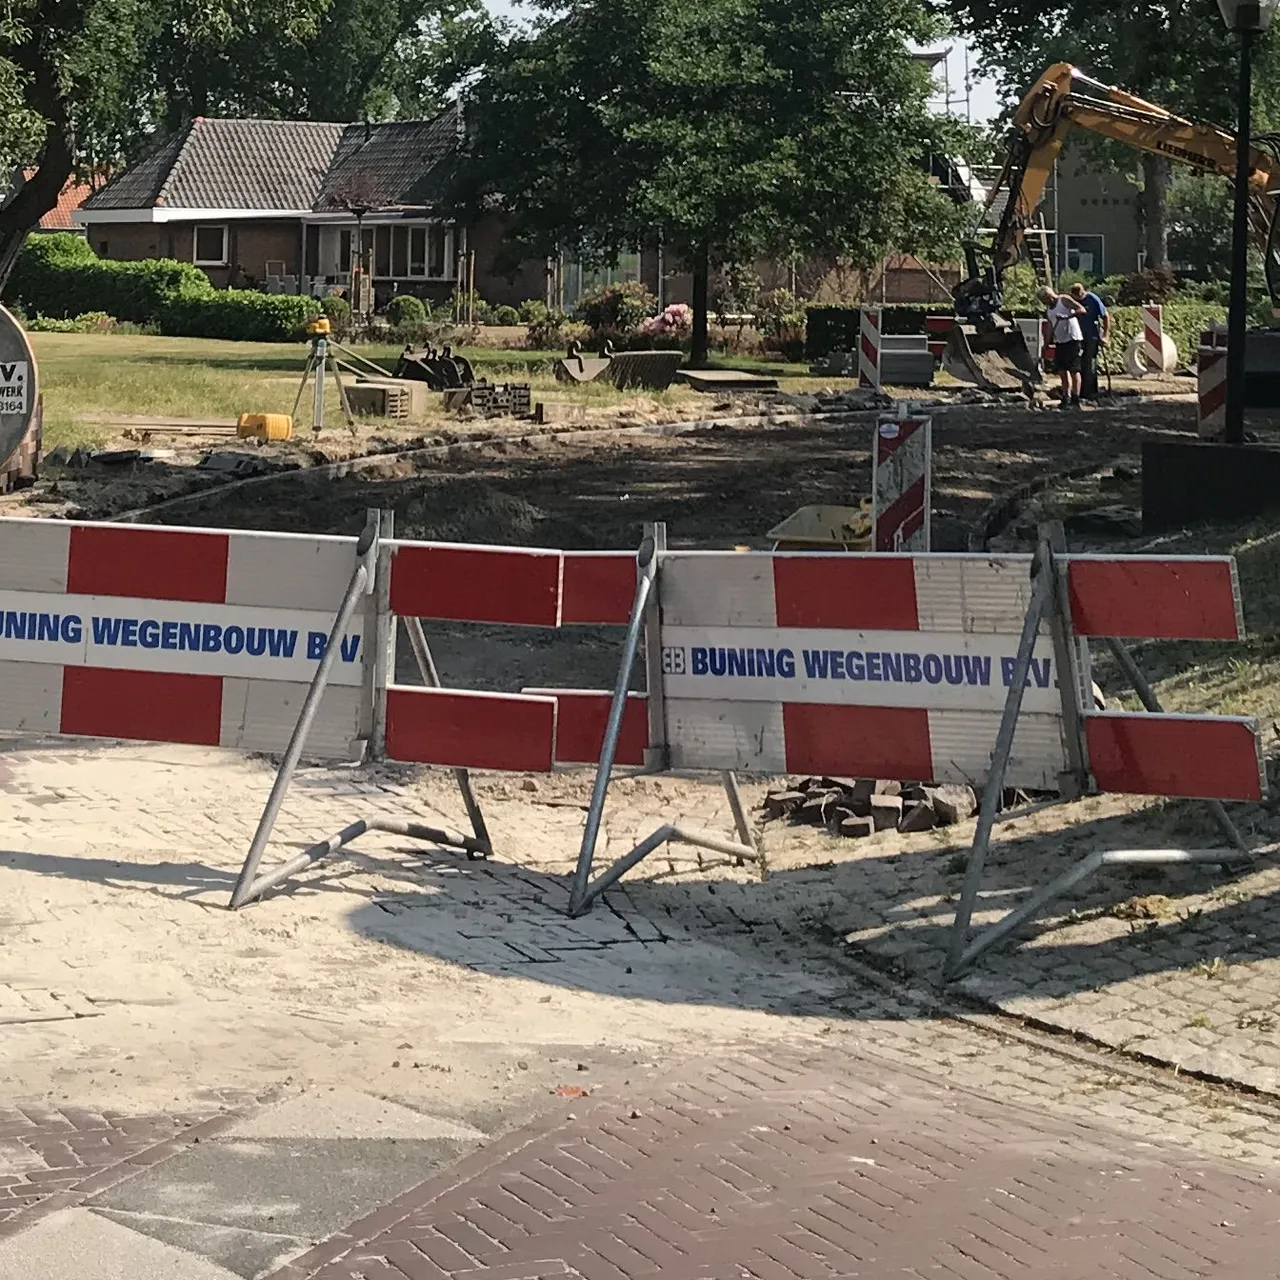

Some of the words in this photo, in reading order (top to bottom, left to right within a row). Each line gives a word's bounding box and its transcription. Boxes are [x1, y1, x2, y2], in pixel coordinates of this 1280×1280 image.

[91, 617, 298, 658] WEGENBOUW
[307, 631, 364, 663] BV.
[691, 647, 796, 678] BUNING
[802, 649, 991, 686] WEGENBOUW
